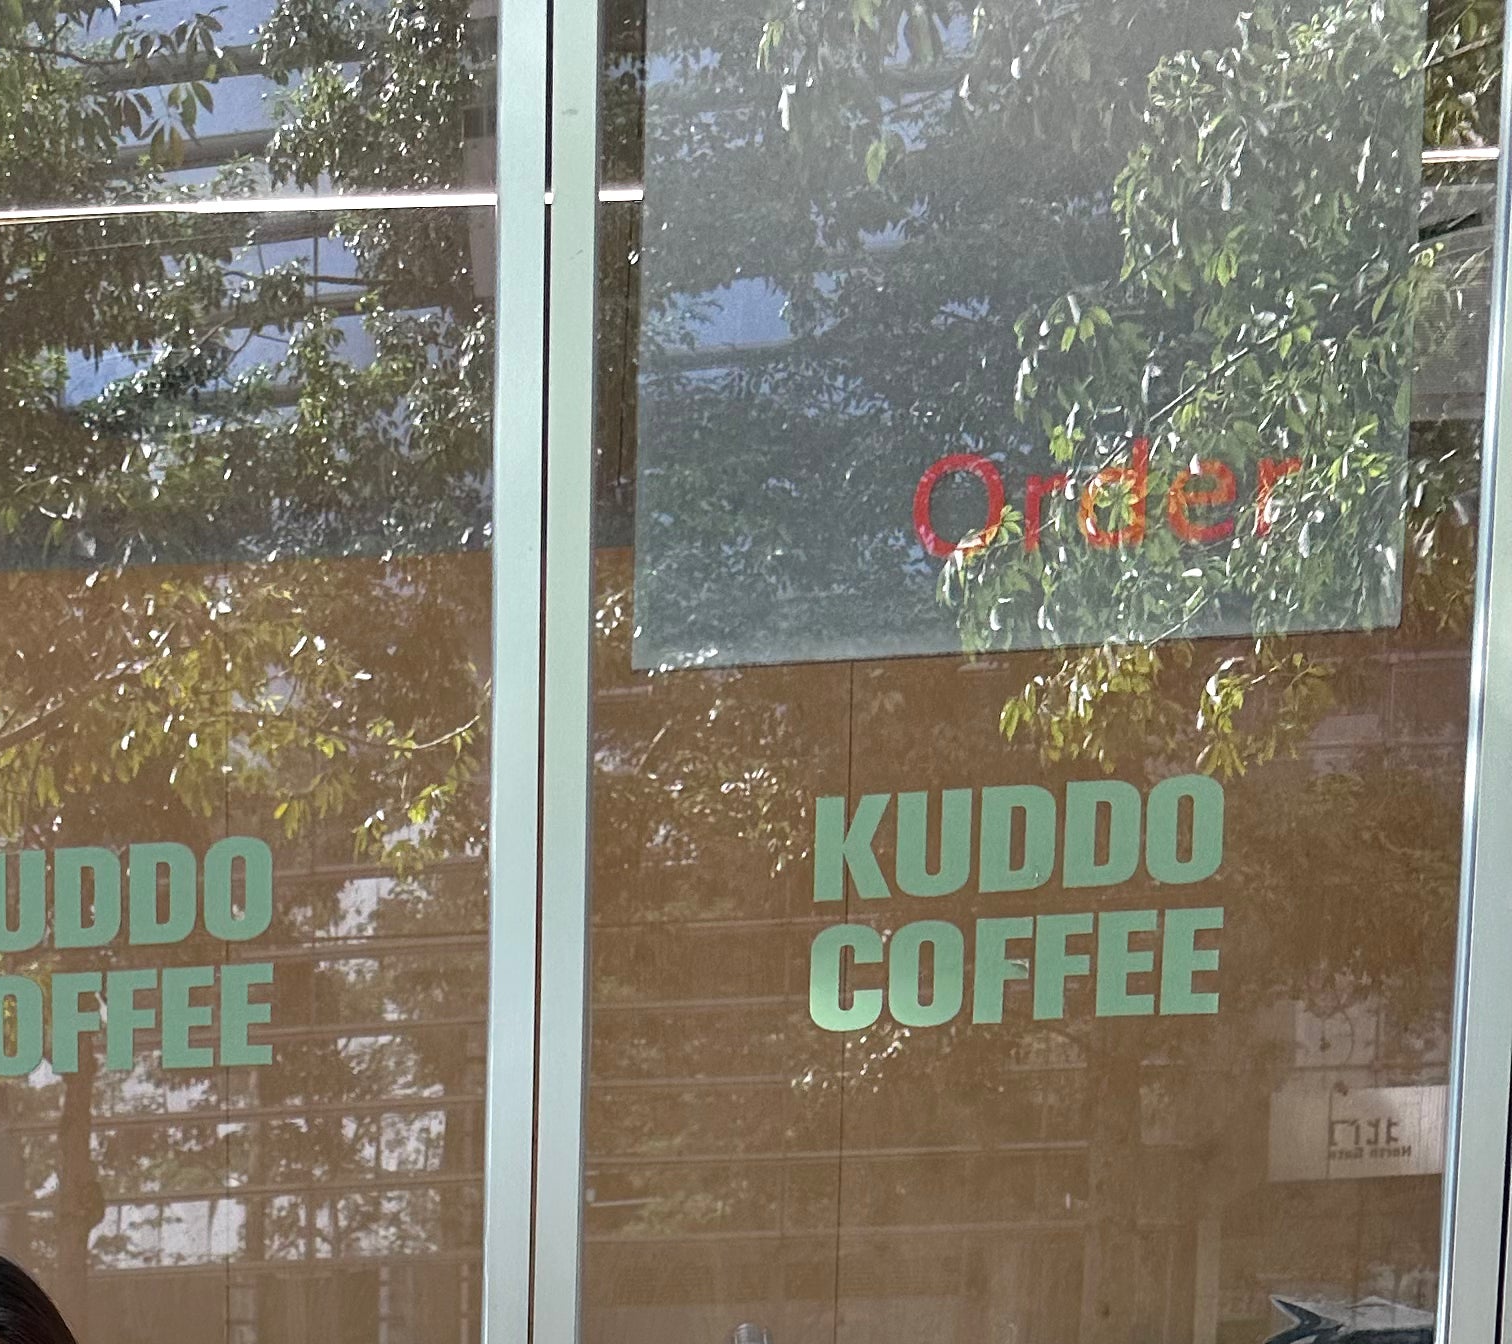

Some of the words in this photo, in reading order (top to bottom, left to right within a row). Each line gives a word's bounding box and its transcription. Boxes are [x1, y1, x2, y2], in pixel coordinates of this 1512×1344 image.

[912, 437, 1305, 558] Order
[813, 774, 1225, 902] KUDDO
[808, 908, 1225, 1032] COFFEE
